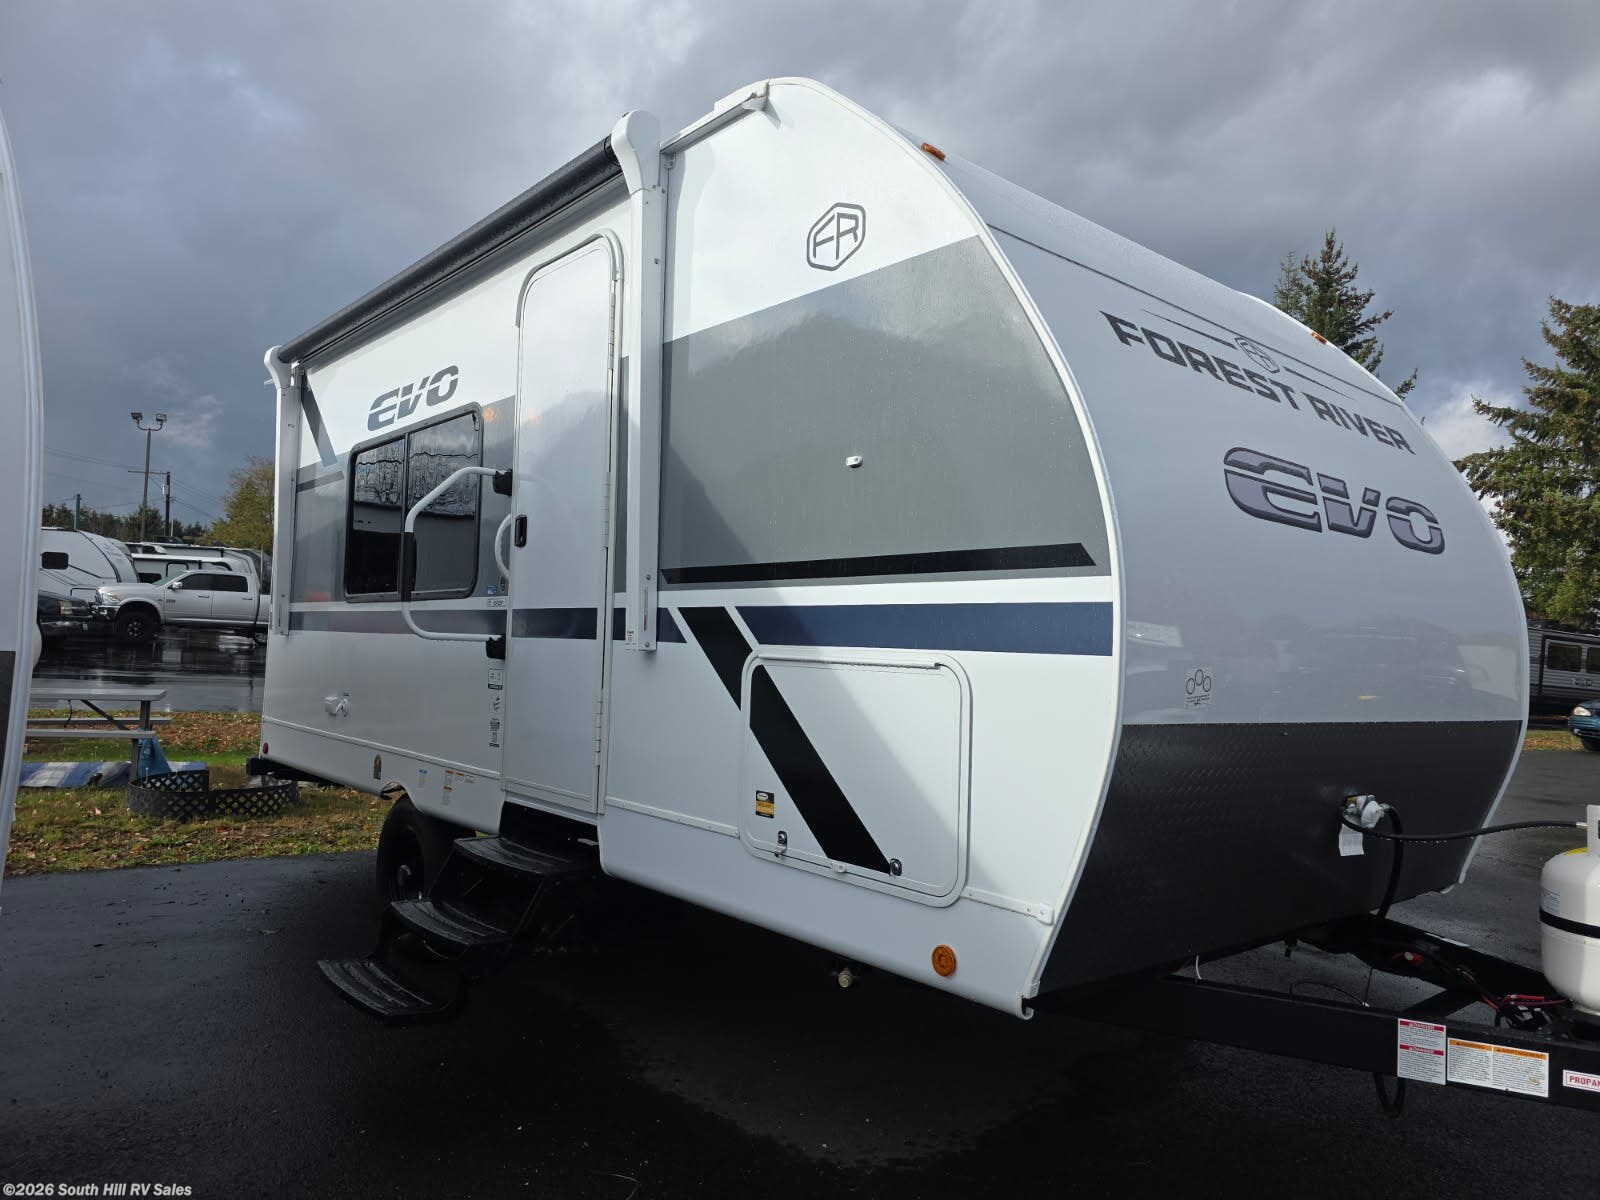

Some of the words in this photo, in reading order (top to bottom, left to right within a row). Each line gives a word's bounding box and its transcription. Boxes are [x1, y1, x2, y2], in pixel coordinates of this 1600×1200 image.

[367, 365, 459, 431] EVO
[1100, 310, 1300, 410] FOREST
[1301, 391, 1416, 455] RIVER
[1223, 446, 1446, 555] EVO
